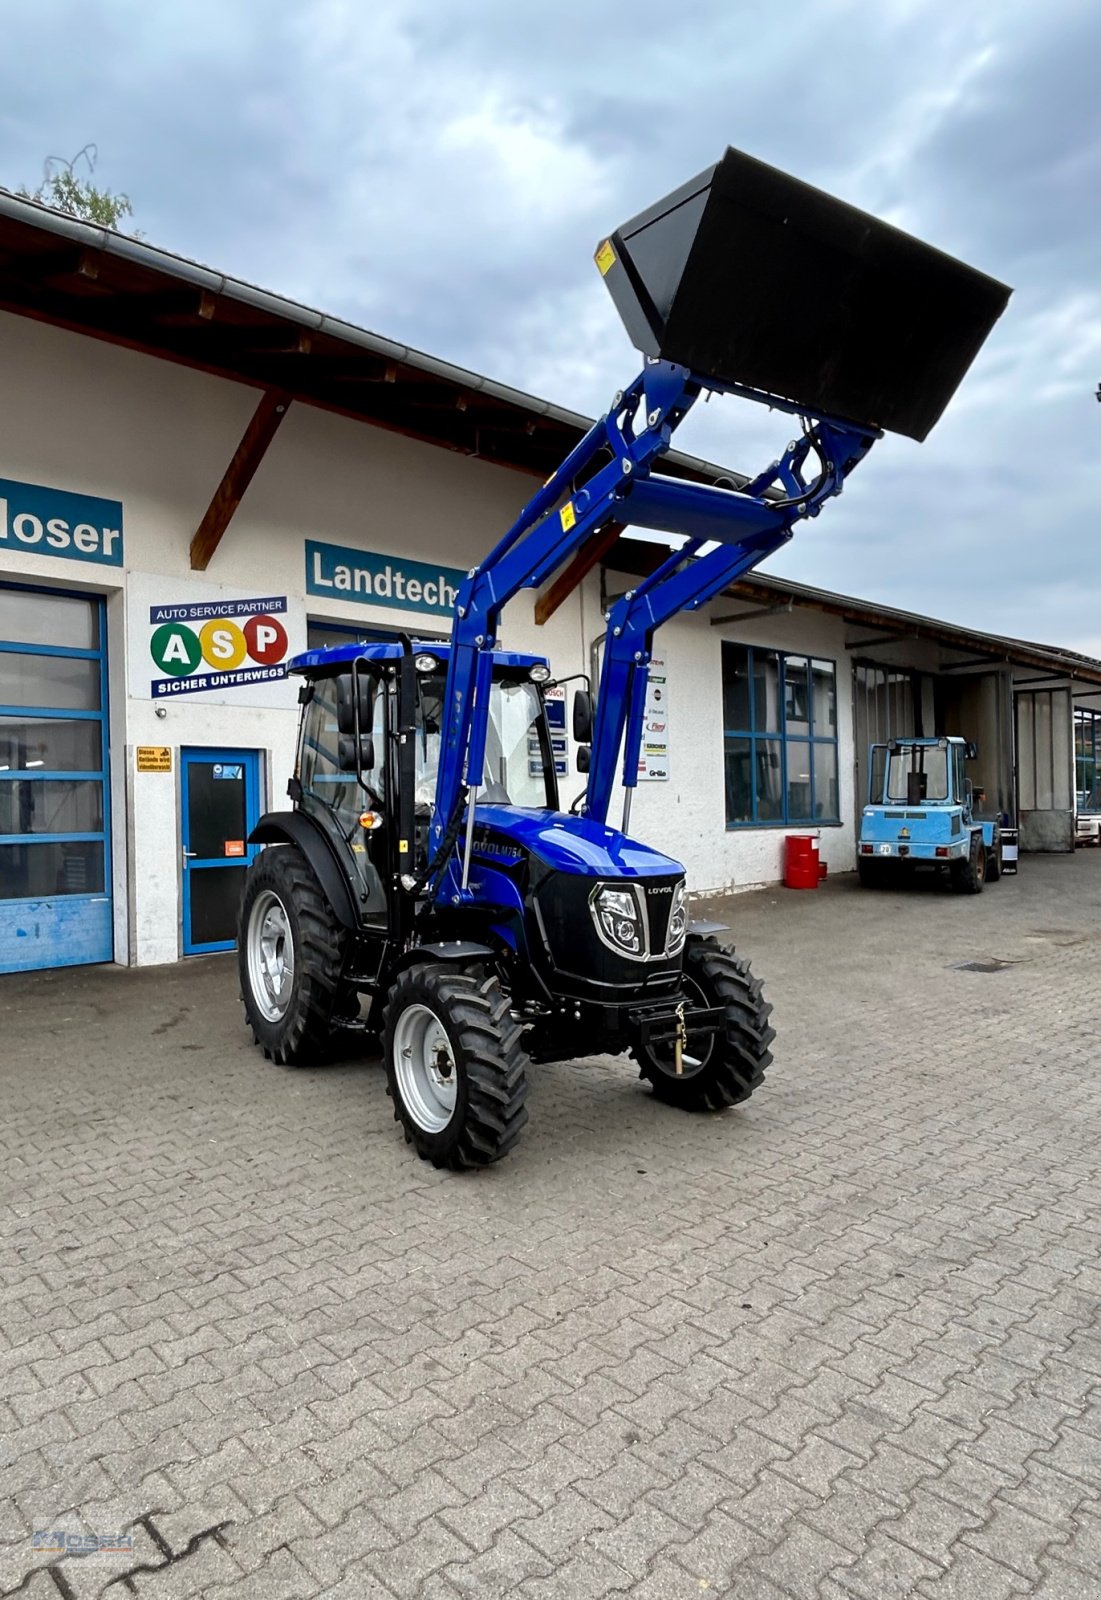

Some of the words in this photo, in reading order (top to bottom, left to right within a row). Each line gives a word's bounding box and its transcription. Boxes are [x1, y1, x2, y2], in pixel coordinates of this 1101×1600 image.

[0, 497, 120, 556] oser
[313, 551, 456, 608] Landtech
[156, 608, 188, 620] AUTO
[190, 604, 235, 617] SERVICE
[237, 600, 282, 613] PARTNER
[158, 678, 207, 693] SICHER
[211, 667, 284, 686] UNTERWEGS
[647, 886, 673, 895] LOVOL
